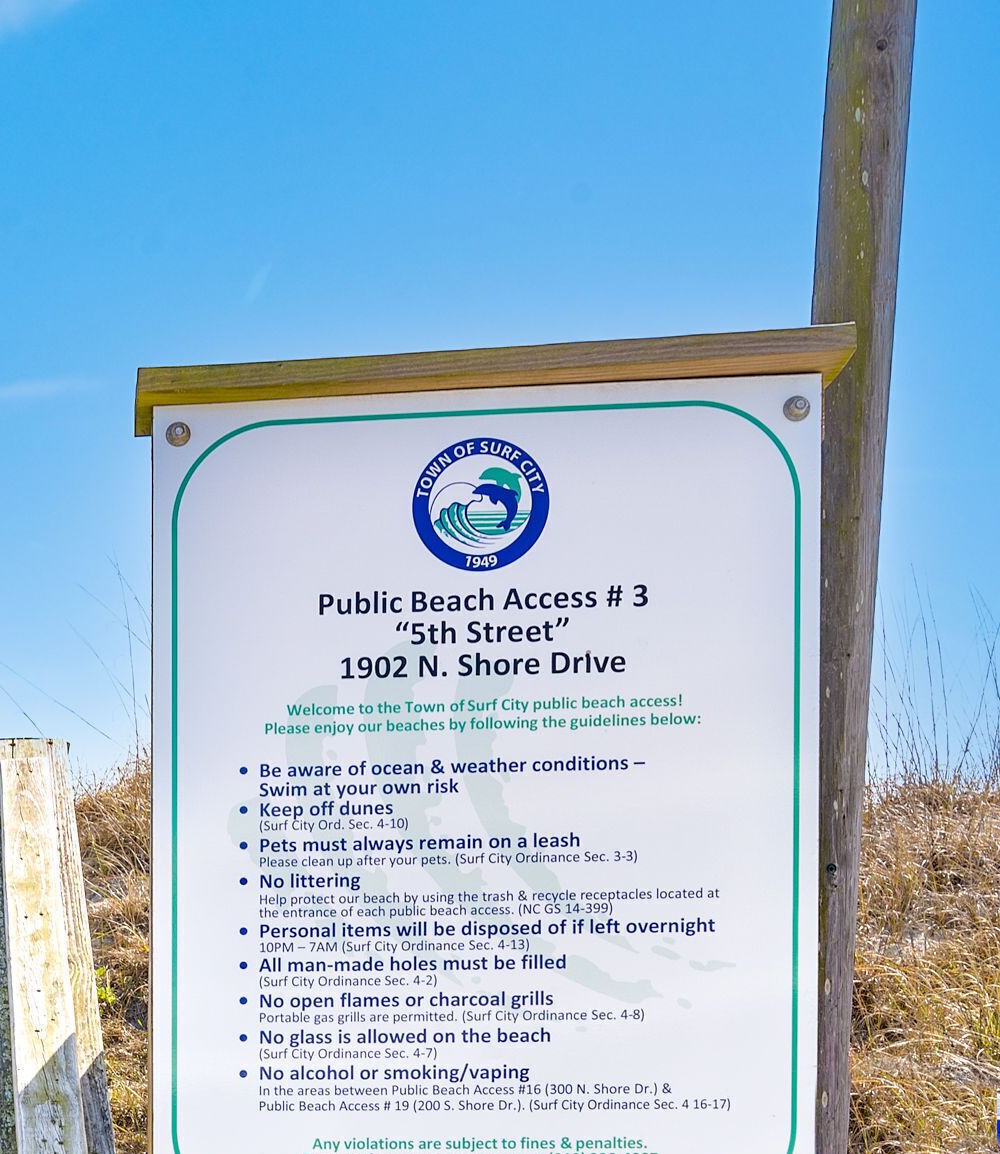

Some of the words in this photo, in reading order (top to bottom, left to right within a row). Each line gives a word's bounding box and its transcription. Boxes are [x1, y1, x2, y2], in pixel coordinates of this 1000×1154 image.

[416, 452, 452, 498] TOWN
[453, 441, 475, 459] OF
[480, 441, 521, 462] SURF
[520, 460, 545, 494] CITY
[465, 555, 498, 568] 1949
[318, 590, 403, 616] Public
[411, 587, 495, 613] Beach
[502, 587, 598, 611] Access
[605, 584, 624, 608] #
[632, 583, 649, 608] 3
[340, 655, 409, 680] 1902
[418, 654, 448, 679] N.
[457, 651, 541, 678] Shore
[550, 649, 627, 675] Drive
[286, 702, 355, 717] Welcome
[358, 703, 375, 715] to
[376, 700, 402, 715] the
[403, 700, 446, 714] Town
[449, 698, 466, 713] of
[467, 697, 499, 713] Surf
[500, 697, 530, 714] City
[532, 696, 578, 714] public
[581, 695, 626, 710] beach
[629, 693, 683, 708] access!
[264, 721, 311, 736] Please
[313, 720, 355, 737] enjoy
[357, 722, 383, 733] our
[385, 718, 446, 733] beaches
[448, 717, 467, 734] by
[469, 715, 539, 732] following
[541, 714, 567, 729] the
[569, 713, 647, 731] guidelines
[650, 711, 701, 726] below:
[259, 763, 282, 779] Be
[287, 764, 343, 778] aware
[347, 760, 367, 777] of
[370, 763, 425, 776] ocean
[429, 758, 446, 775] &
[450, 756, 528, 774] weather
[531, 755, 629, 773] conditions
[258, 781, 308, 798] Swim
[312, 781, 332, 797] at
[335, 783, 378, 800] your
[382, 782, 422, 796] own
[427, 777, 460, 795] risk
[259, 802, 304, 820] Keep
[309, 800, 336, 817] off
[339, 799, 394, 817] dunes
[259, 819, 289, 834] (Surf
[291, 818, 316, 833] City
[317, 817, 345, 831] Ord.
[348, 818, 374, 830] Sec.
[376, 816, 409, 832] 4-10)
[259, 837, 298, 854] Pets
[302, 837, 348, 853] must
[352, 835, 414, 855] always
[419, 833, 483, 851] remain
[488, 836, 512, 849] on
[516, 836, 528, 849] a
[533, 831, 581, 849] leash
[259, 855, 299, 868] Please
[301, 855, 334, 868] clean
[337, 857, 354, 869] up
[356, 853, 387, 867] after
[388, 856, 418, 869] your
[420, 854, 452, 868] pets.
[454, 851, 486, 868] (Surf
[488, 852, 513, 867] City
[515, 851, 581, 864] Ordinance
[583, 850, 610, 863] Sec.
[613, 849, 638, 864] 3-3)
[259, 873, 285, 889] No
[290, 872, 361, 892] littering
[259, 921, 337, 939] Personal
[341, 921, 392, 938] items
[395, 920, 428, 938] will
[433, 920, 456, 937] be
[460, 918, 542, 940] disposed
[547, 918, 568, 935] of
[571, 917, 586, 935] if
[589, 917, 621, 935] left
[625, 916, 716, 937] overnight
[259, 941, 294, 954] 10PM
[308, 941, 338, 953] 7AM
[341, 940, 372, 955] (Surf
[374, 940, 398, 955] City
[400, 939, 465, 952] Ordinance
[468, 939, 494, 951] Sec.
[497, 937, 530, 953] 4-13)
[258, 956, 282, 973] All
[287, 955, 385, 973] man-made
[389, 955, 438, 972] holes
[442, 956, 489, 972] must
[493, 954, 516, 971] be
[520, 953, 567, 970] filled
[259, 993, 285, 1009] No
[289, 996, 335, 1012] open
[339, 991, 400, 1008] flames
[404, 995, 425, 1008] or
[429, 990, 506, 1008] charcoal
[510, 989, 554, 1011] grills
[259, 1029, 285, 1045] No
[289, 1028, 333, 1049] glass
[338, 1028, 352, 1045] is
[356, 1027, 427, 1045] allowed
[432, 1031, 456, 1044] on
[460, 1027, 492, 1044] the
[496, 1026, 551, 1044] beach
[259, 1065, 285, 1081] No
[289, 1064, 355, 1081] alcohol
[359, 1068, 380, 1081] or
[383, 1062, 531, 1084] smoking/vaping
[311, 1137, 341, 1153] Any
[343, 1136, 415, 1151] violations
[417, 1139, 442, 1150] are
[445, 1136, 499, 1153] subject
[500, 1137, 517, 1150] to
[519, 1136, 556, 1150] fines
[559, 1136, 573, 1150] &
[575, 1135, 648, 1153] penalties.
